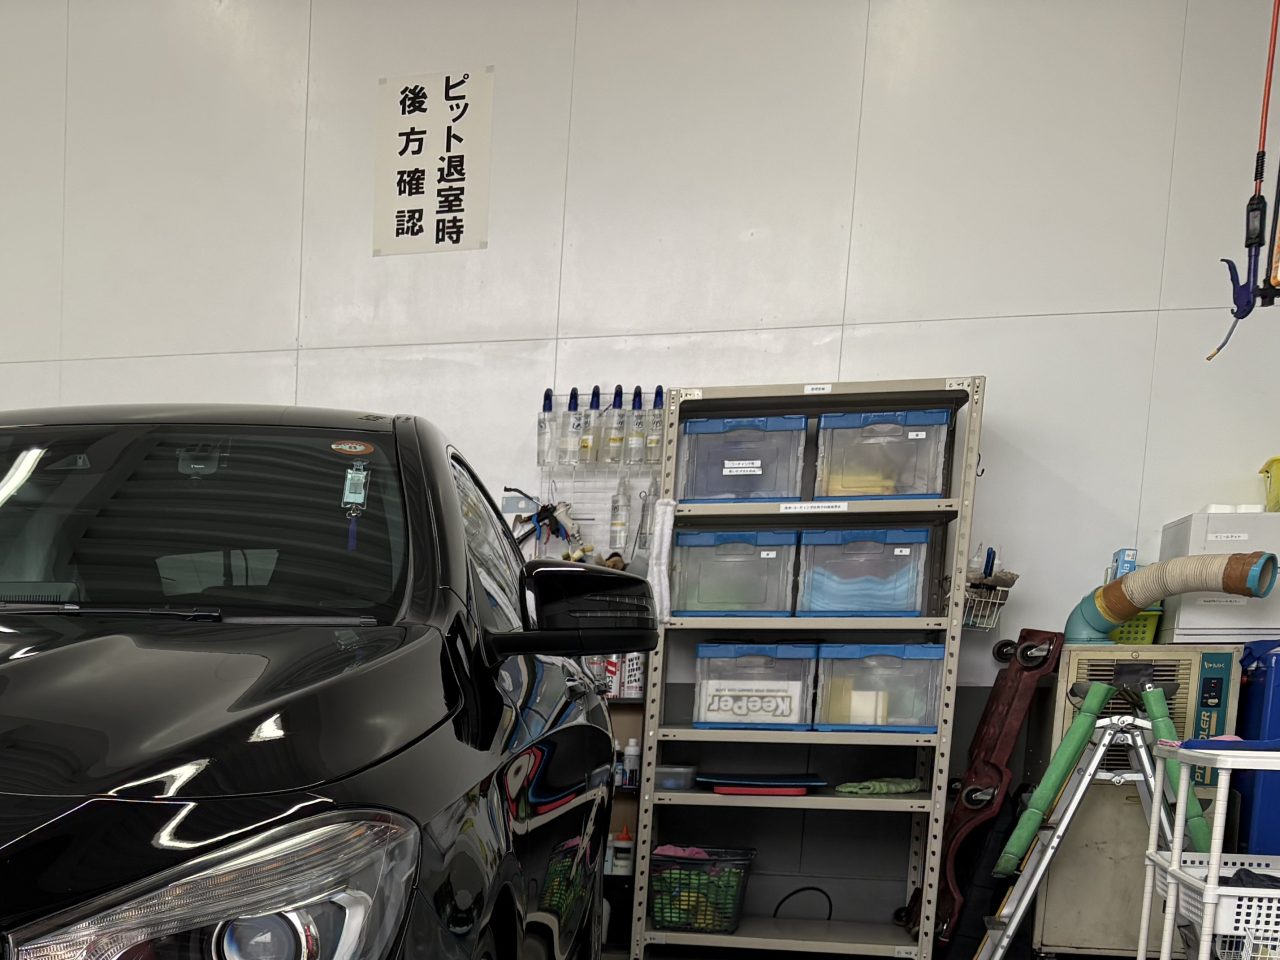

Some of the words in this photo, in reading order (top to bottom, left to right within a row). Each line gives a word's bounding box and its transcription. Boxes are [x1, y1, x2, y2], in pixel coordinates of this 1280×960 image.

[395, 84, 428, 238] 後方確認
[434, 73, 470, 245] ピット退室時
[707, 694, 792, 717] KeePer
